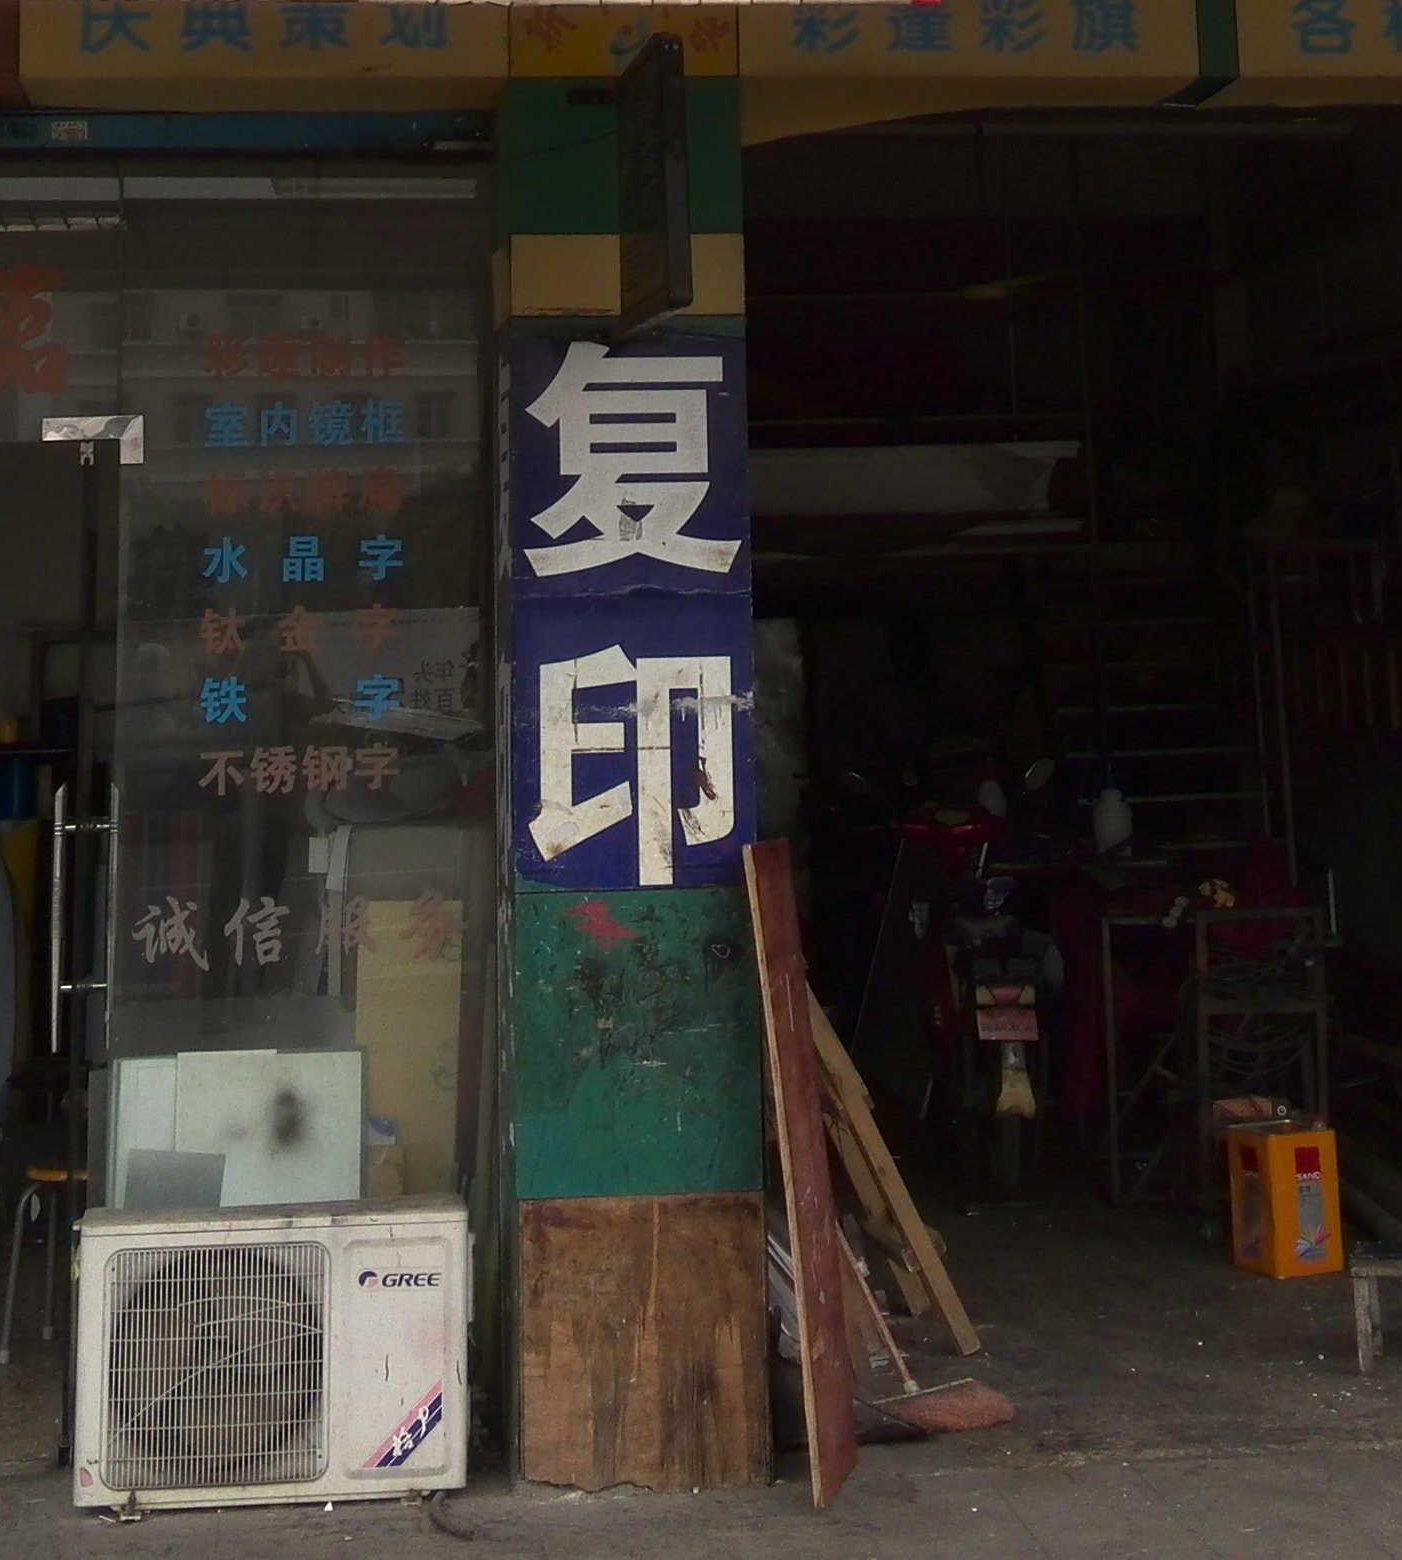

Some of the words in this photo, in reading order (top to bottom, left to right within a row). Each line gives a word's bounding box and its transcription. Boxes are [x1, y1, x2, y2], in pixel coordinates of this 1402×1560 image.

[204, 399, 405, 447] 室内镜框
[201, 534, 405, 584] 水晶字
[523, 341, 743, 887] 复印
[198, 742, 401, 798] 不锈钢字
[381, 1272, 442, 1288] GREE
